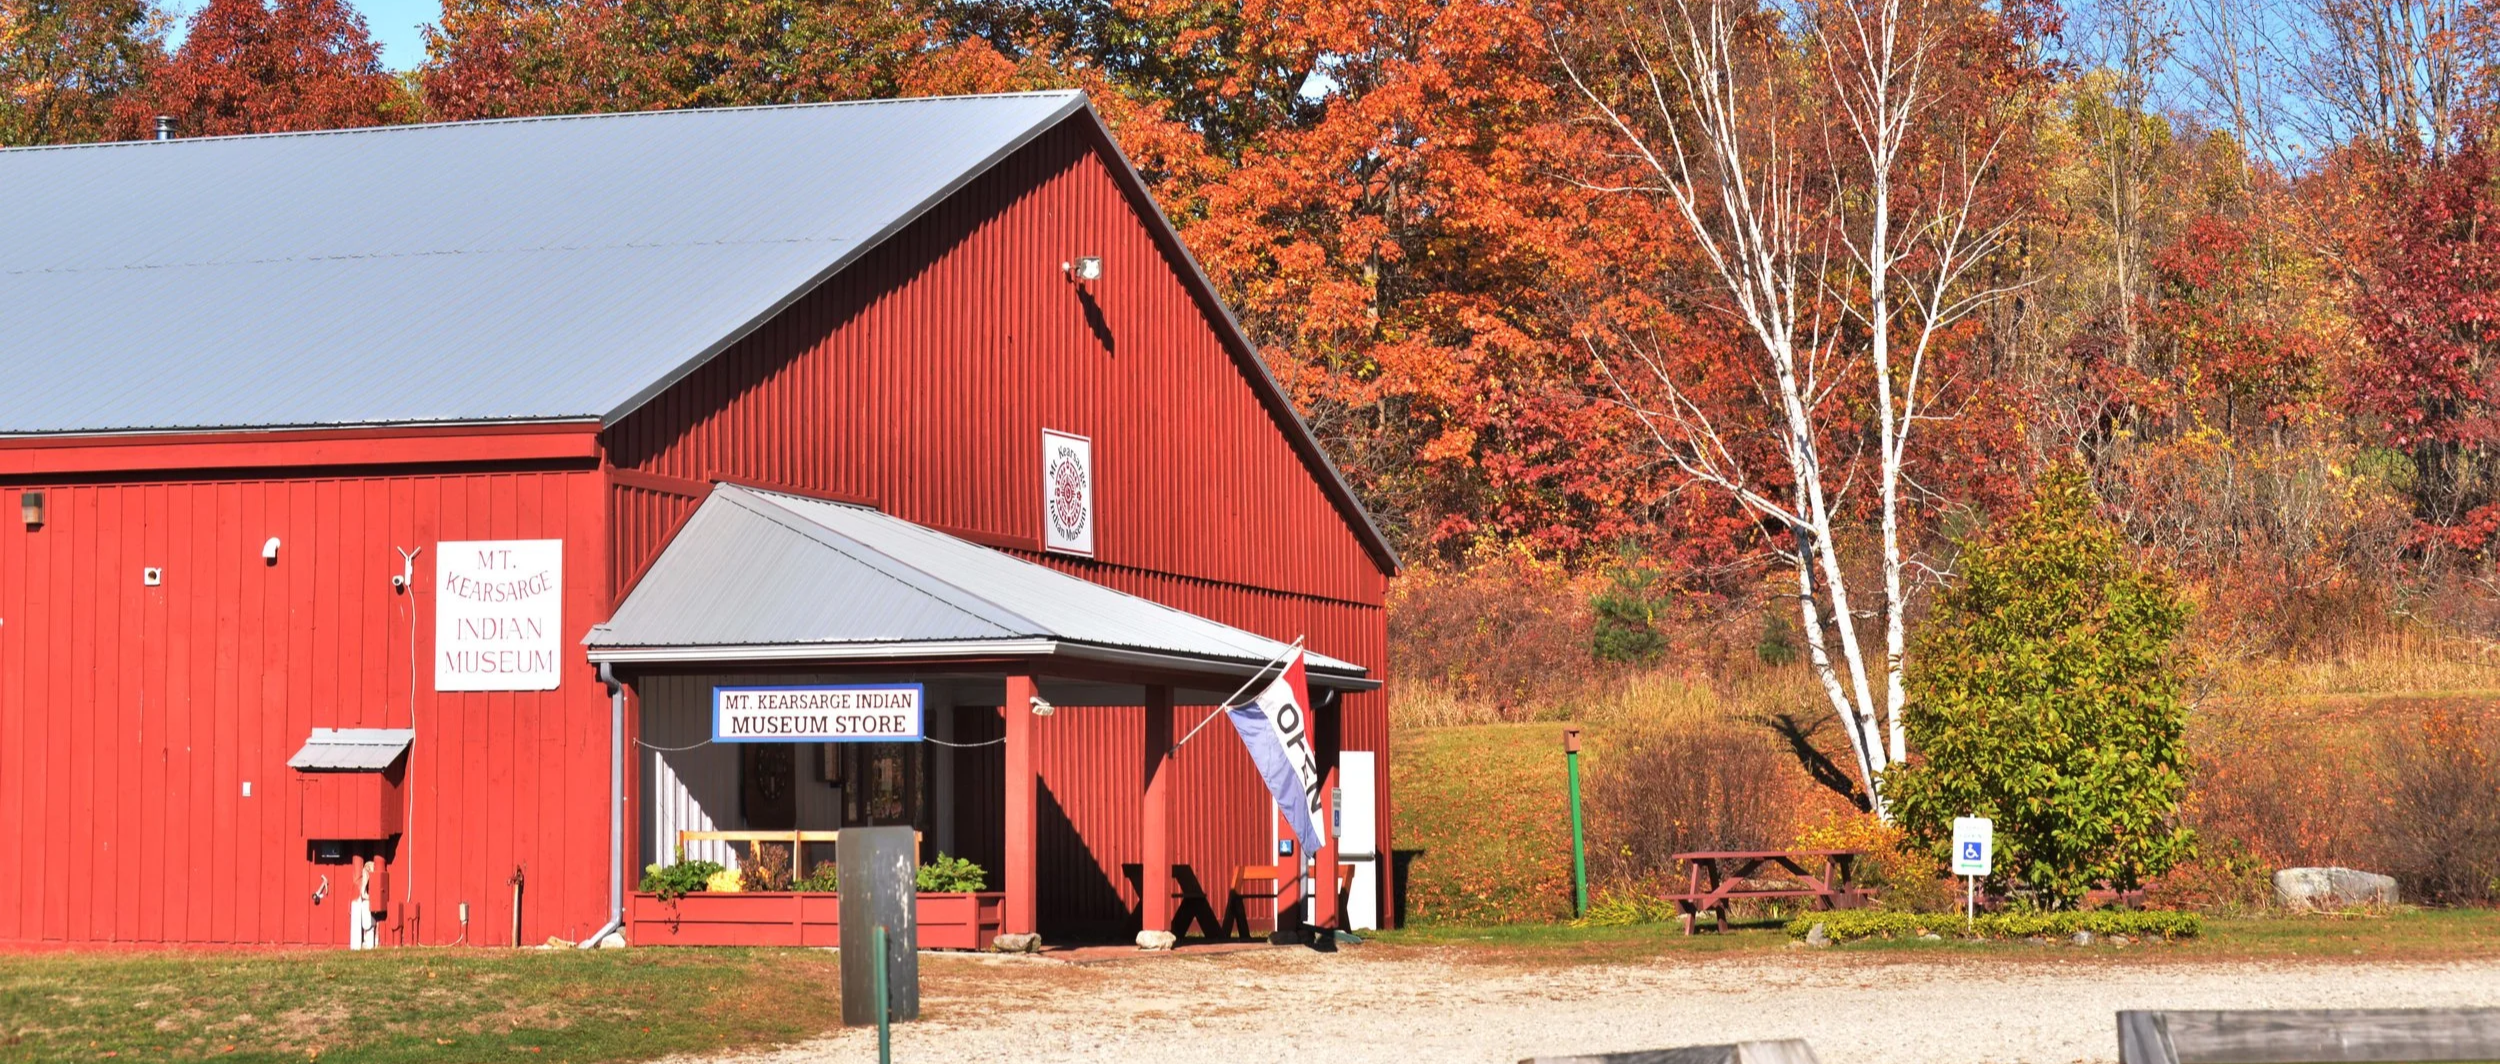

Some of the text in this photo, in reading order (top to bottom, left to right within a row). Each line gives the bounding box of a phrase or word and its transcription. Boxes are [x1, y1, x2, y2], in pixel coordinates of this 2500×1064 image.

[1058, 445, 1087, 488] Kearsarge
[1050, 500, 1087, 541] Indian Museum
[477, 550, 517, 570] MT.
[446, 570, 553, 602] KEARSARGE
[457, 617, 542, 640] INDIAN
[445, 650, 553, 674] MUSEUM
[726, 693, 912, 710] MT. KEARSARGE INDIAN
[731, 715, 906, 734] MUSEUM STORE
